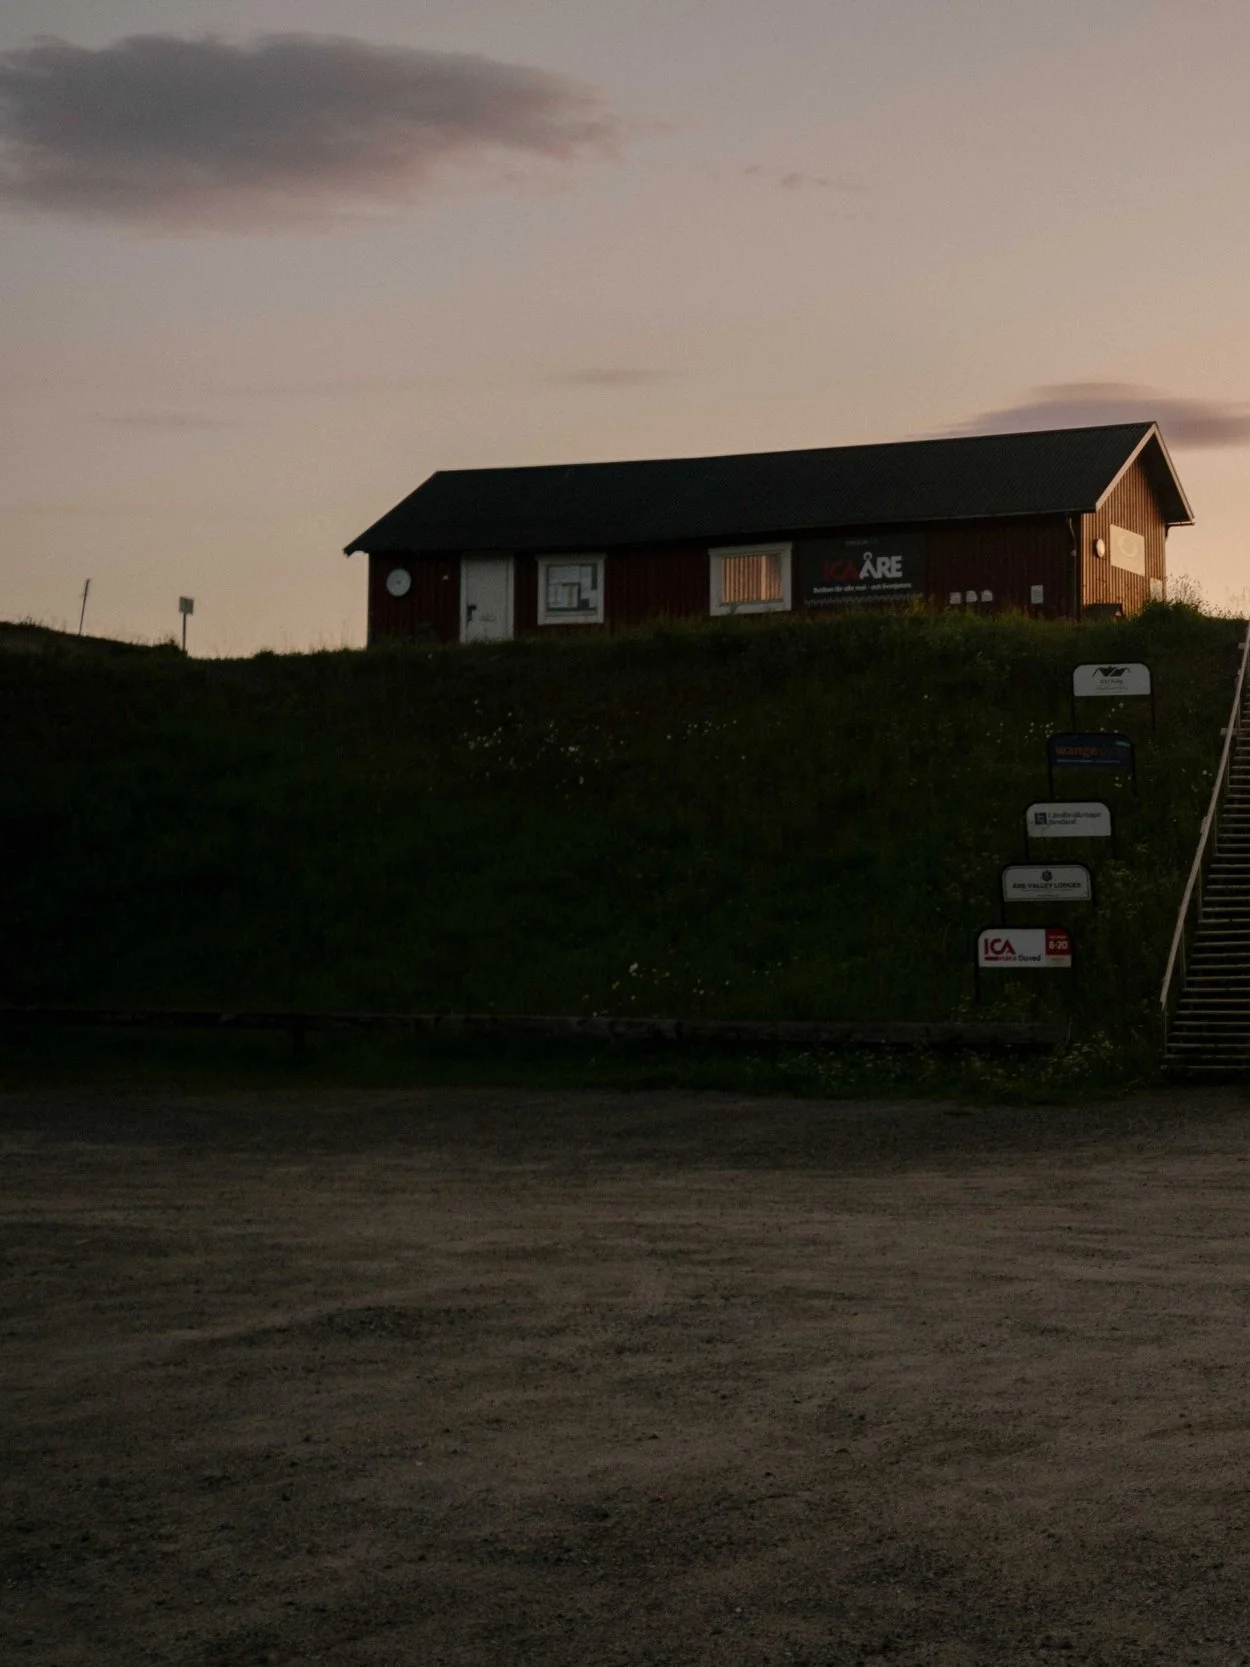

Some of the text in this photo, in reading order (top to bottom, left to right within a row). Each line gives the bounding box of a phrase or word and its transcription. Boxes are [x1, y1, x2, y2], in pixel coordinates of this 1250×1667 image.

[859, 552, 903, 580] ÅRE
[984, 938, 1016, 956] ICA
[1048, 940, 1069, 950] 8-20
[1018, 954, 1041, 962] Duved
